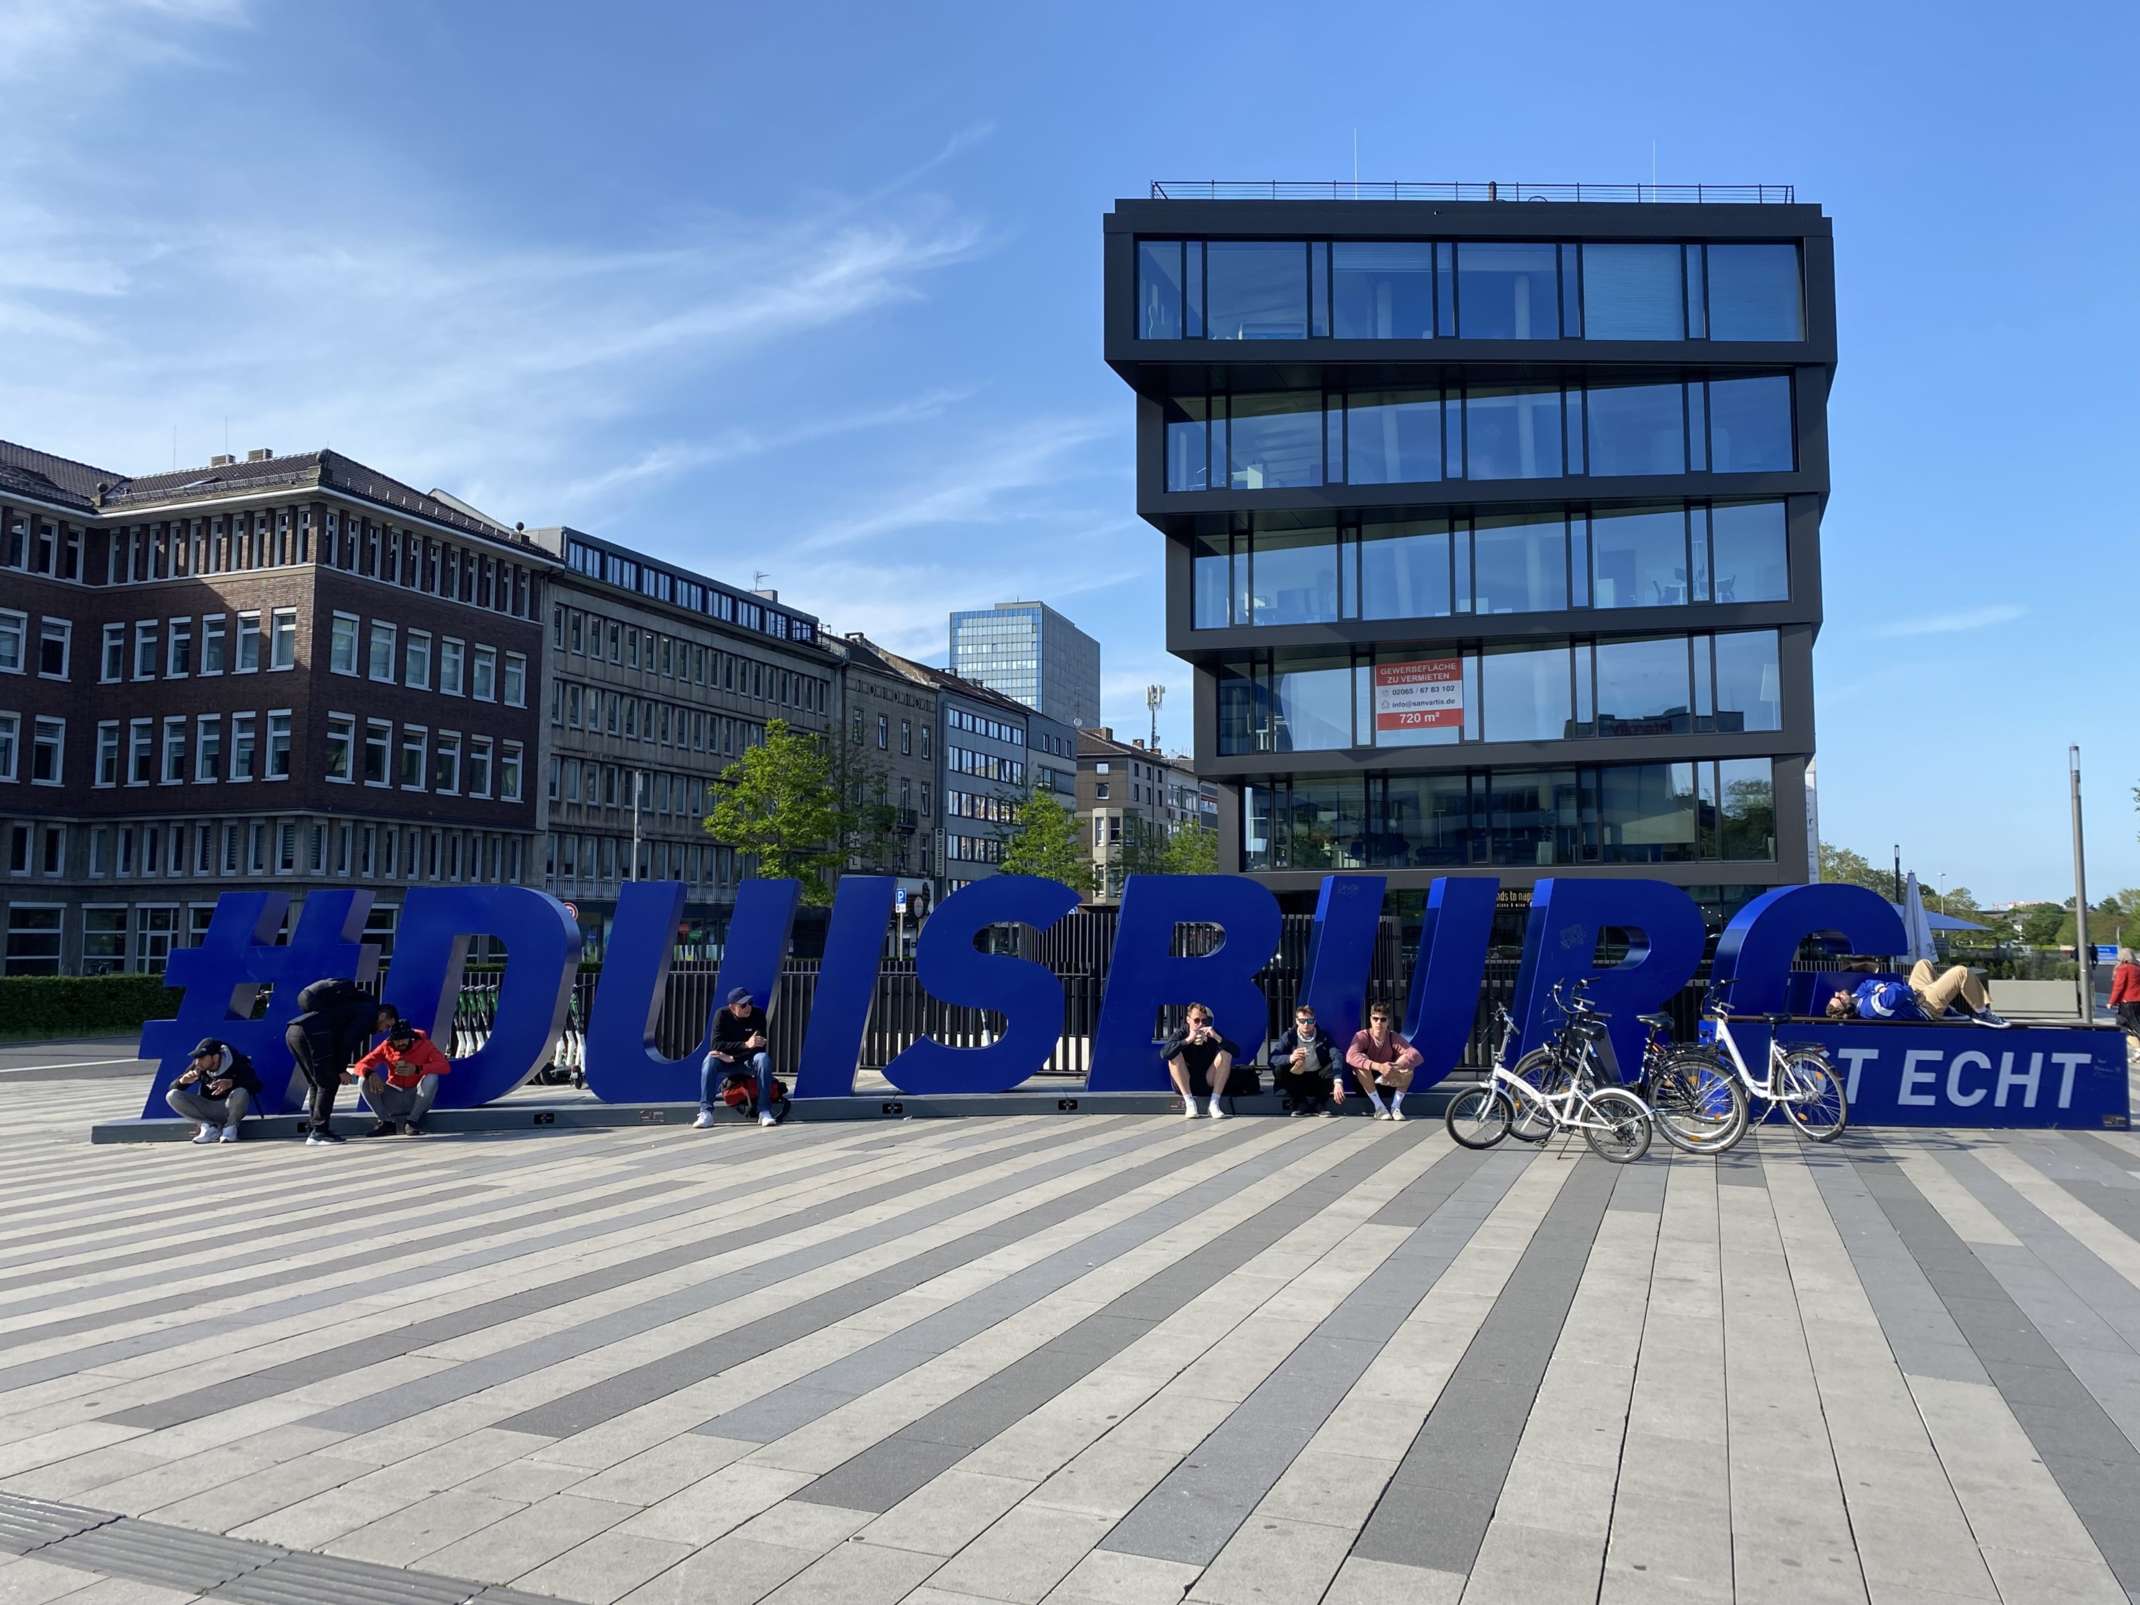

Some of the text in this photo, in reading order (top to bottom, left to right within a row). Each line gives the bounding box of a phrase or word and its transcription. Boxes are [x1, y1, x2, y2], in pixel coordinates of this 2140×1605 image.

[1387, 672, 1450, 684] ZU VERMIETEN
[1399, 713, 1421, 724] 720
[1897, 1049, 2092, 1109] ECHT
